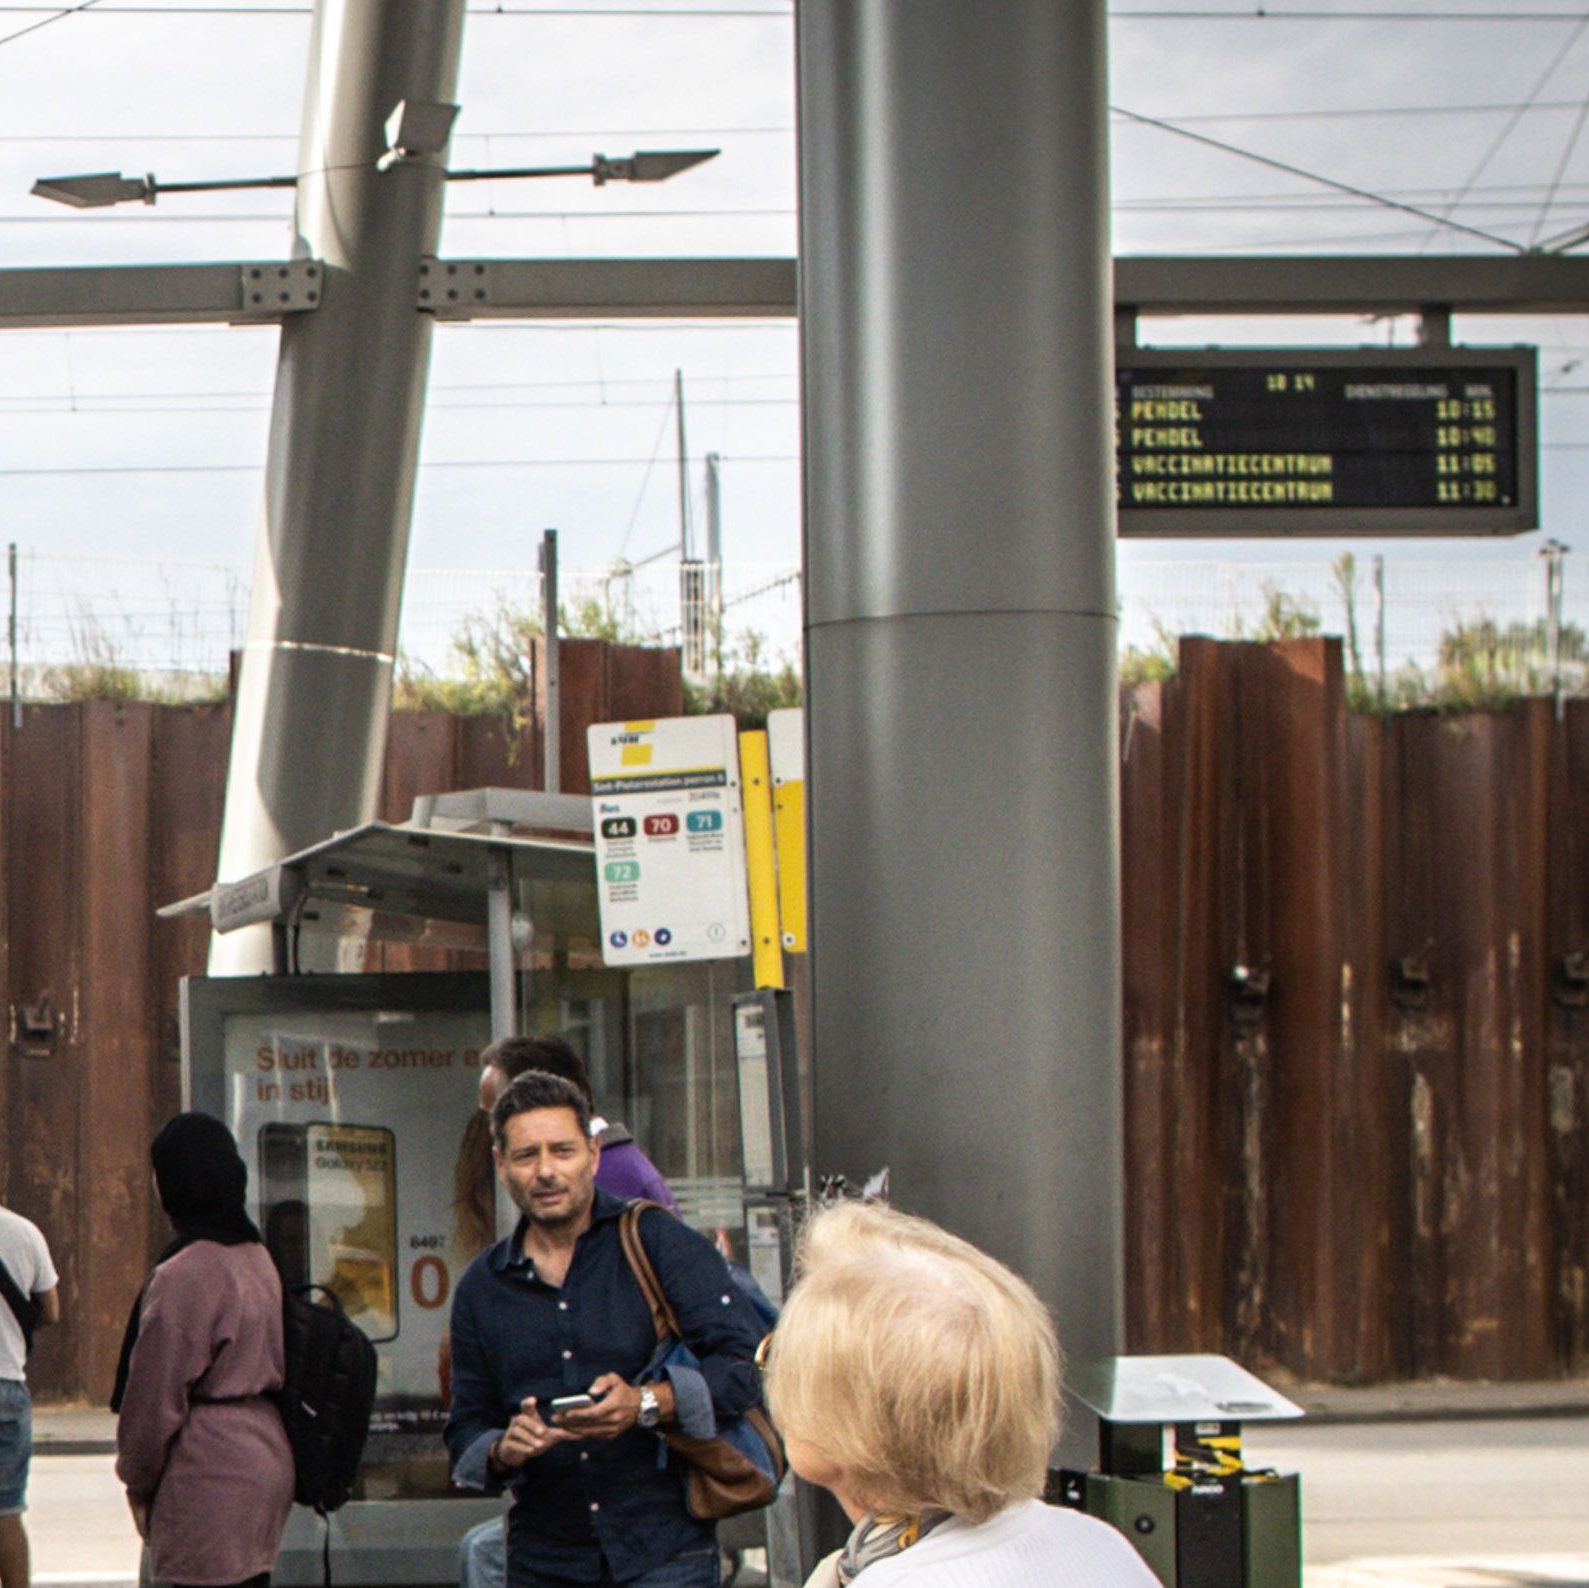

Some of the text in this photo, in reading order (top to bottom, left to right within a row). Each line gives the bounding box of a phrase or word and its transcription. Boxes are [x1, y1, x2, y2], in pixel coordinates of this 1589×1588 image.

[1131, 400, 1203, 421] PENDEL
[1131, 427, 1203, 448] PENDEL
[1132, 453, 1333, 475] VACCINATIECENTRUM
[1132, 480, 1333, 502] VACCINATIECENTRUM
[608, 814, 713, 836] 44 70 71
[612, 864, 631, 879] 72
[255, 1046, 317, 1072] Sluit
[326, 1047, 360, 1069] de
[369, 1050, 452, 1069] zomer
[257, 1077, 280, 1101] in
